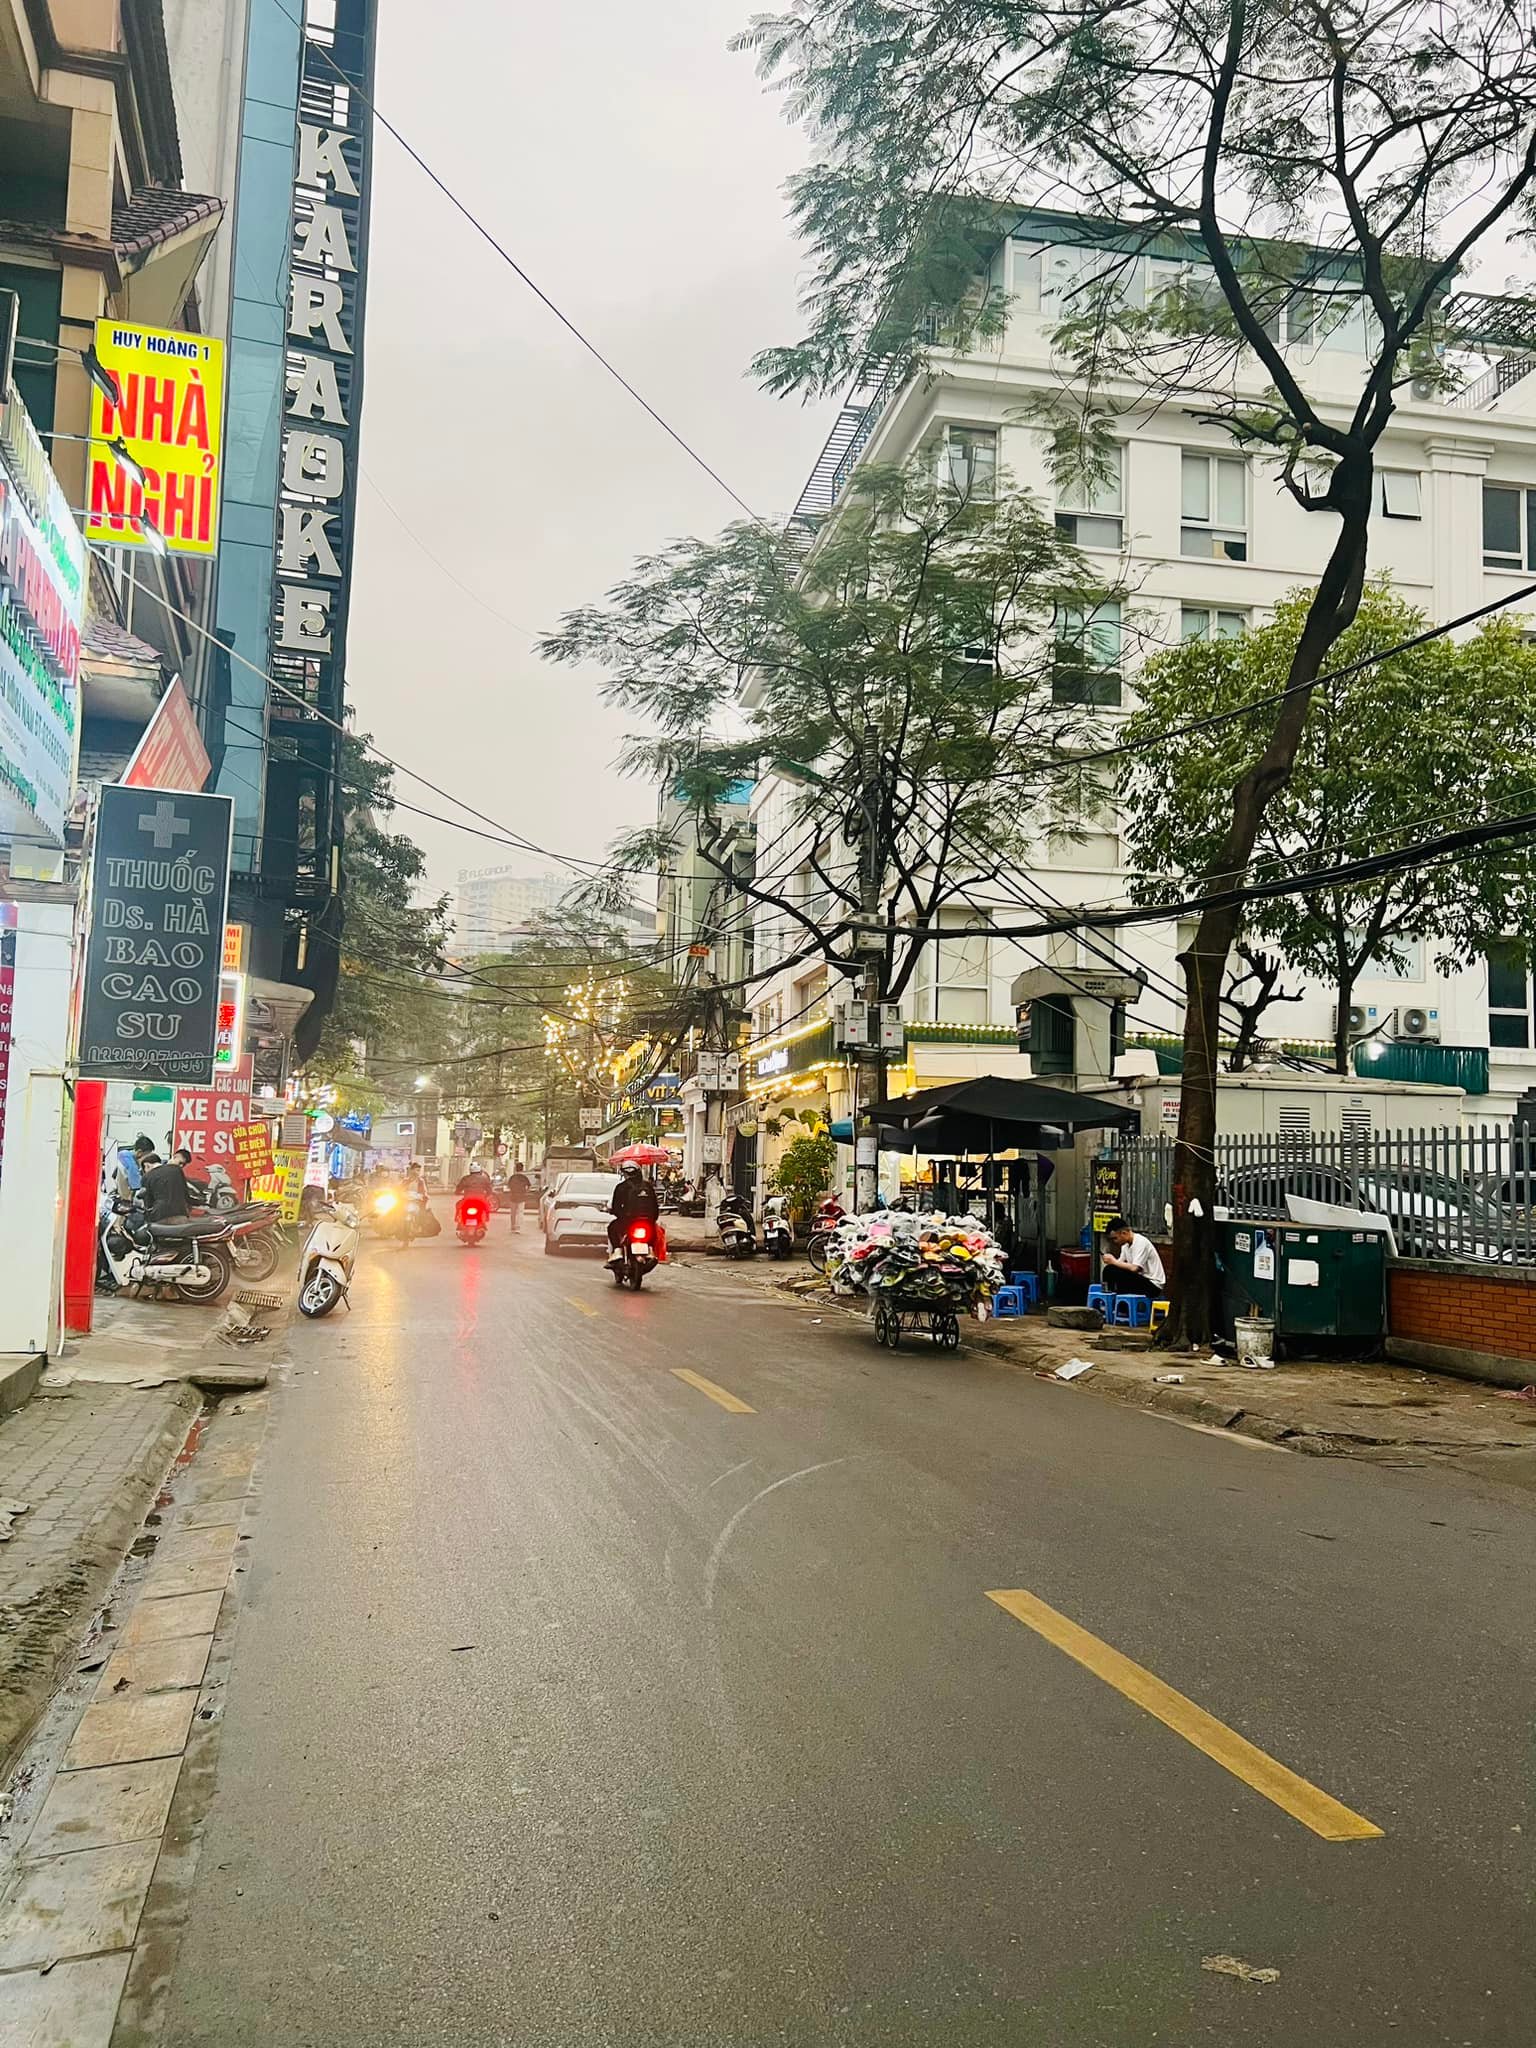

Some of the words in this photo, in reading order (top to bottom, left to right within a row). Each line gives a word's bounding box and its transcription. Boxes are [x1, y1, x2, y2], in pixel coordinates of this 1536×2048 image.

[112, 330, 142, 349] HUY
[147, 336, 198, 359] HOÀNG
[202, 346, 210, 361] 1
[275, 121, 360, 656] KARAOKE
[100, 367, 211, 450] NHÀ
[89, 452, 216, 543] NGHỈ
[106, 850, 215, 894] THUỐC
[102, 898, 154, 931] Ds.
[163, 897, 210, 935] HÀ
[104, 936, 204, 968] BAO
[101, 973, 202, 1004] CAO
[116, 1011, 182, 1040] SU
[216, 1078, 232, 1092] CÁC
[232, 1079, 250, 1097] LOẠI
[179, 1098, 208, 1121] XE
[215, 1099, 245, 1122] GA
[178, 1130, 206, 1153] XE
